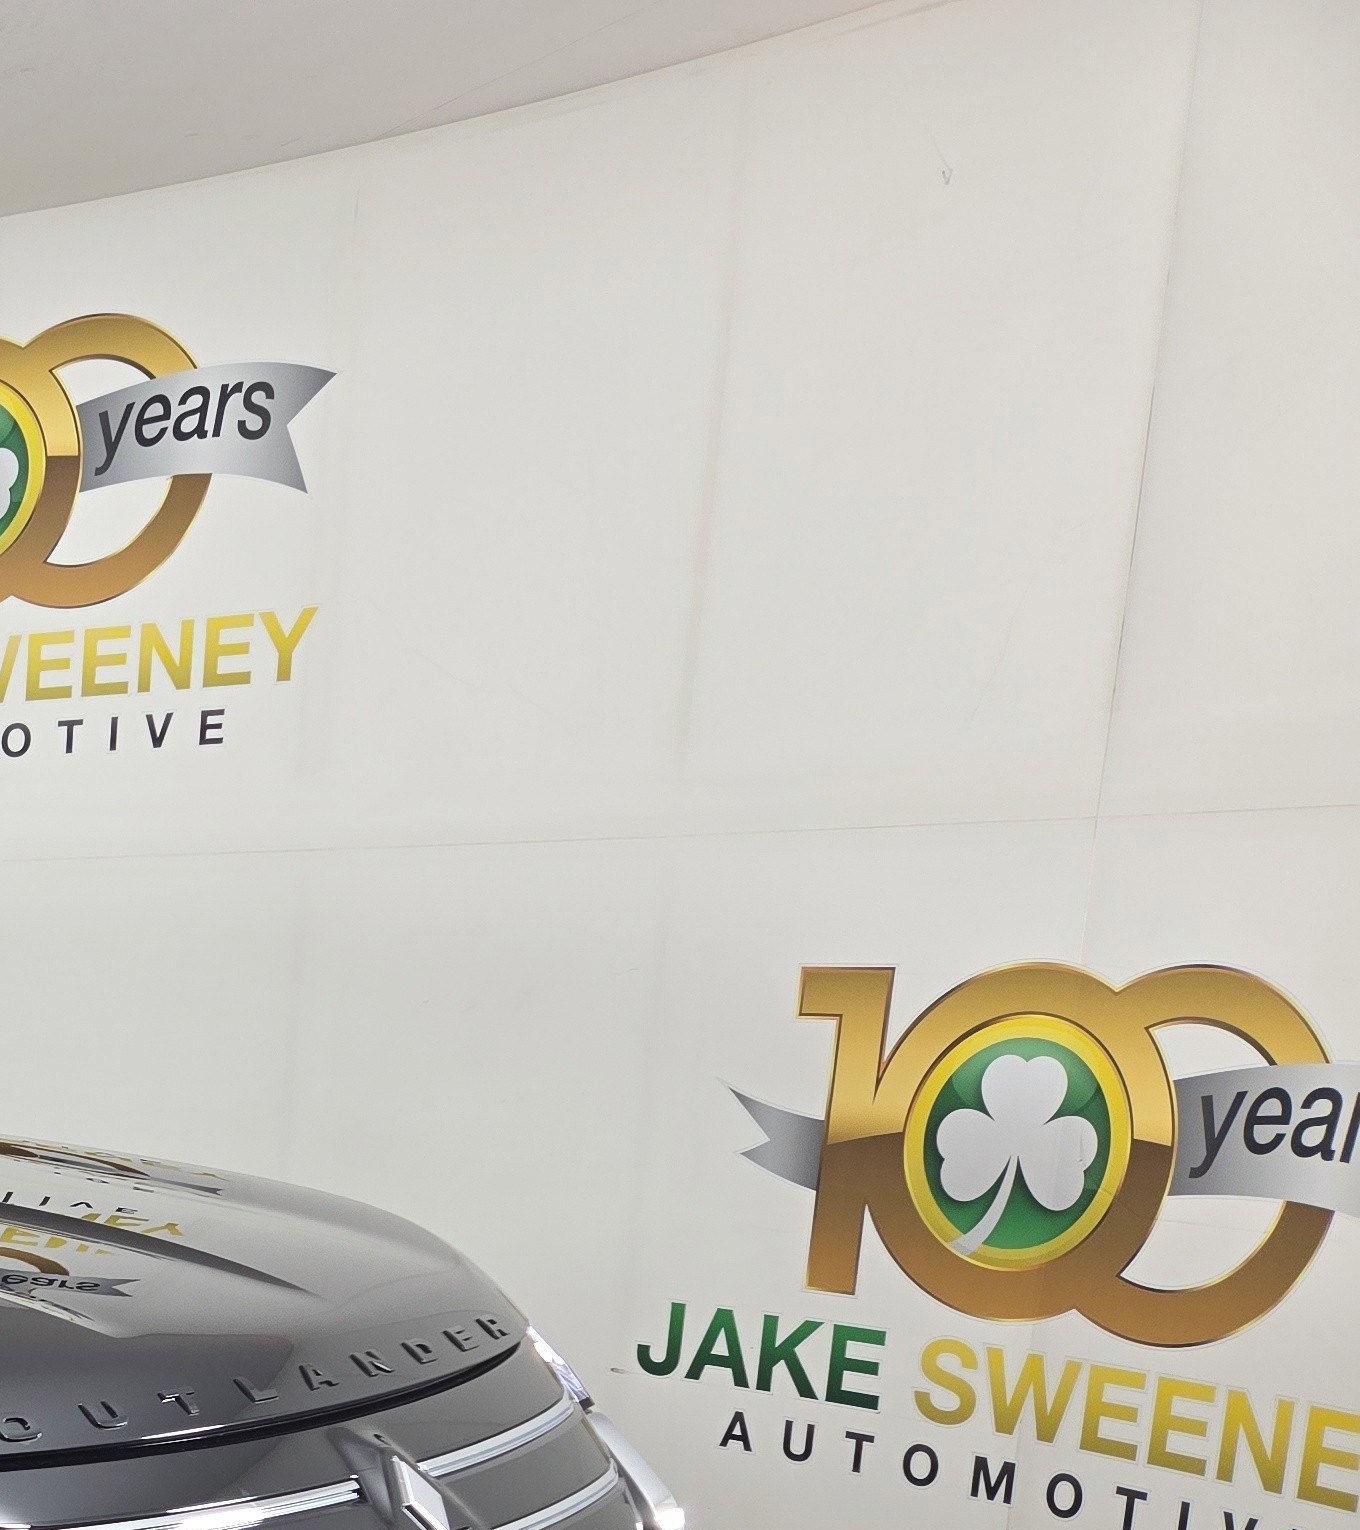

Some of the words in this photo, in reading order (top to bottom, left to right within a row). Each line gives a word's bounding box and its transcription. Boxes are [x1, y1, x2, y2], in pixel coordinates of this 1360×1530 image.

[94, 380, 276, 475] years
[797, 961, 1336, 1349] 100
[636, 1301, 887, 1411] JAKE
